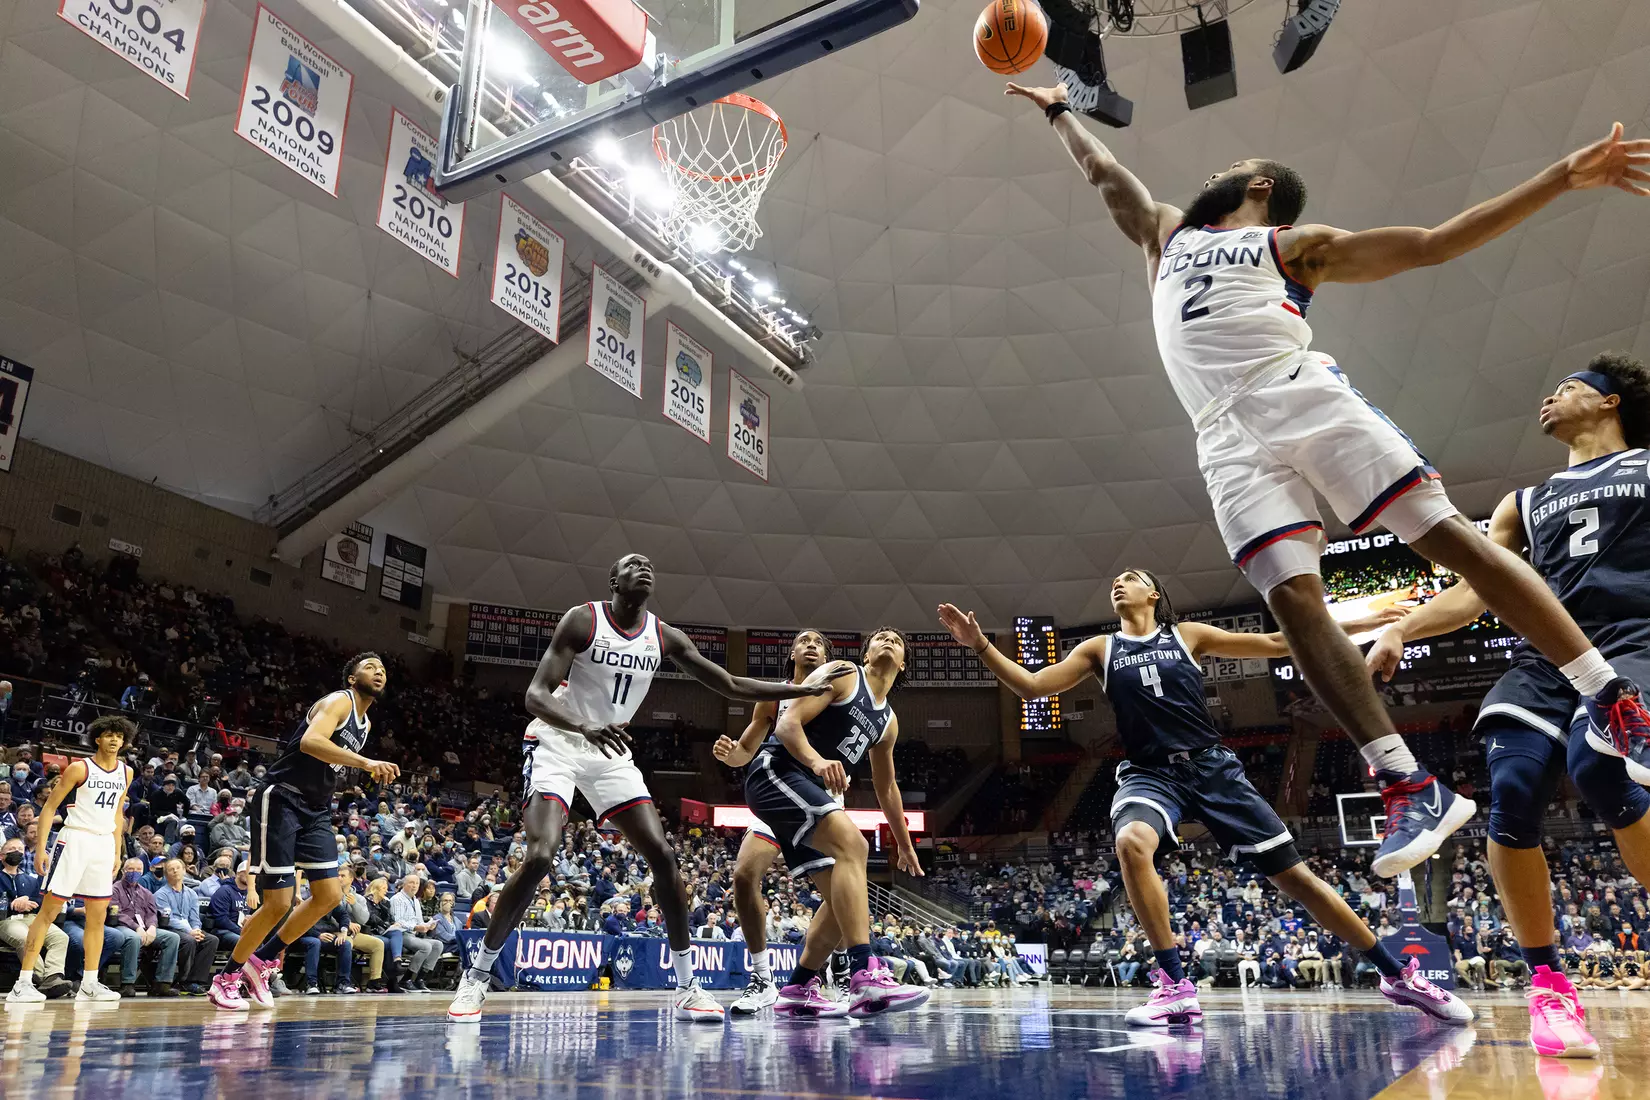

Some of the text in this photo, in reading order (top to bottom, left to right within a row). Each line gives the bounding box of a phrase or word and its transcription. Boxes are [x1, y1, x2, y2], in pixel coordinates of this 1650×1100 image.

[88, 2, 171, 66] NATIONAL
[109, 0, 186, 54] 004
[517, 0, 605, 68] arm
[77, 13, 175, 84] CHAMPIONS
[267, 14, 345, 77] UConn Women's
[280, 36, 330, 78] Basketball
[279, 79, 317, 112] FOUR
[251, 85, 334, 155] 2009
[400, 117, 427, 143] UConn
[249, 128, 326, 185] CHAMPIONS
[257, 116, 323, 168] NATIONAL
[411, 136, 437, 160] Basket
[393, 184, 453, 239] 2010
[508, 201, 560, 244] UConn Women's
[388, 221, 450, 268] CHAMPIONS
[394, 210, 447, 253] NATIONAL
[517, 216, 550, 246] Basketball
[1160, 246, 1264, 281] UCONN
[504, 263, 552, 309] 2013
[1181, 274, 1214, 322] 2
[500, 296, 551, 335] CHAMPIONS
[505, 286, 549, 321] NATIONAL
[596, 326, 636, 367] 2014
[597, 348, 634, 378] NATIONAL
[593, 358, 636, 391] CHAMPIONS
[670, 379, 704, 415] 2015
[671, 399, 703, 425] NATIONAL
[668, 408, 706, 437] CHAMPIONS
[734, 423, 764, 455] 2016
[732, 450, 764, 476] CHAMPIONS
[734, 442, 762, 466] NATIONAL
[1531, 483, 1647, 527] GEORGETOWN
[1324, 536, 1371, 556] RSITY
[1373, 533, 1395, 548] OF
[1568, 507, 1601, 558] 2
[124, 545, 141, 556] 210
[472, 604, 563, 622] BIG EAST CONFER
[1101, 623, 1120, 631] UCO
[591, 648, 658, 672] UCONN
[1113, 650, 1182, 671] GEORGETOWN
[1219, 662, 1237, 676] 22
[1275, 665, 1293, 680] 40
[612, 672, 633, 705] 11
[1138, 663, 1164, 698] 4
[44, 718, 86, 733] SEC 10
[848, 706, 879, 744] GEORGETOWN
[836, 725, 870, 764] 23
[88, 780, 126, 791] UCONN
[94, 791, 117, 810] 44
[1179, 843, 1195, 851] 114
[1469, 828, 1487, 837] 116
[947, 853, 960, 861] 113
[514, 938, 603, 970] UCONN
[659, 943, 724, 972] UONN
[744, 948, 797, 972] UONN
